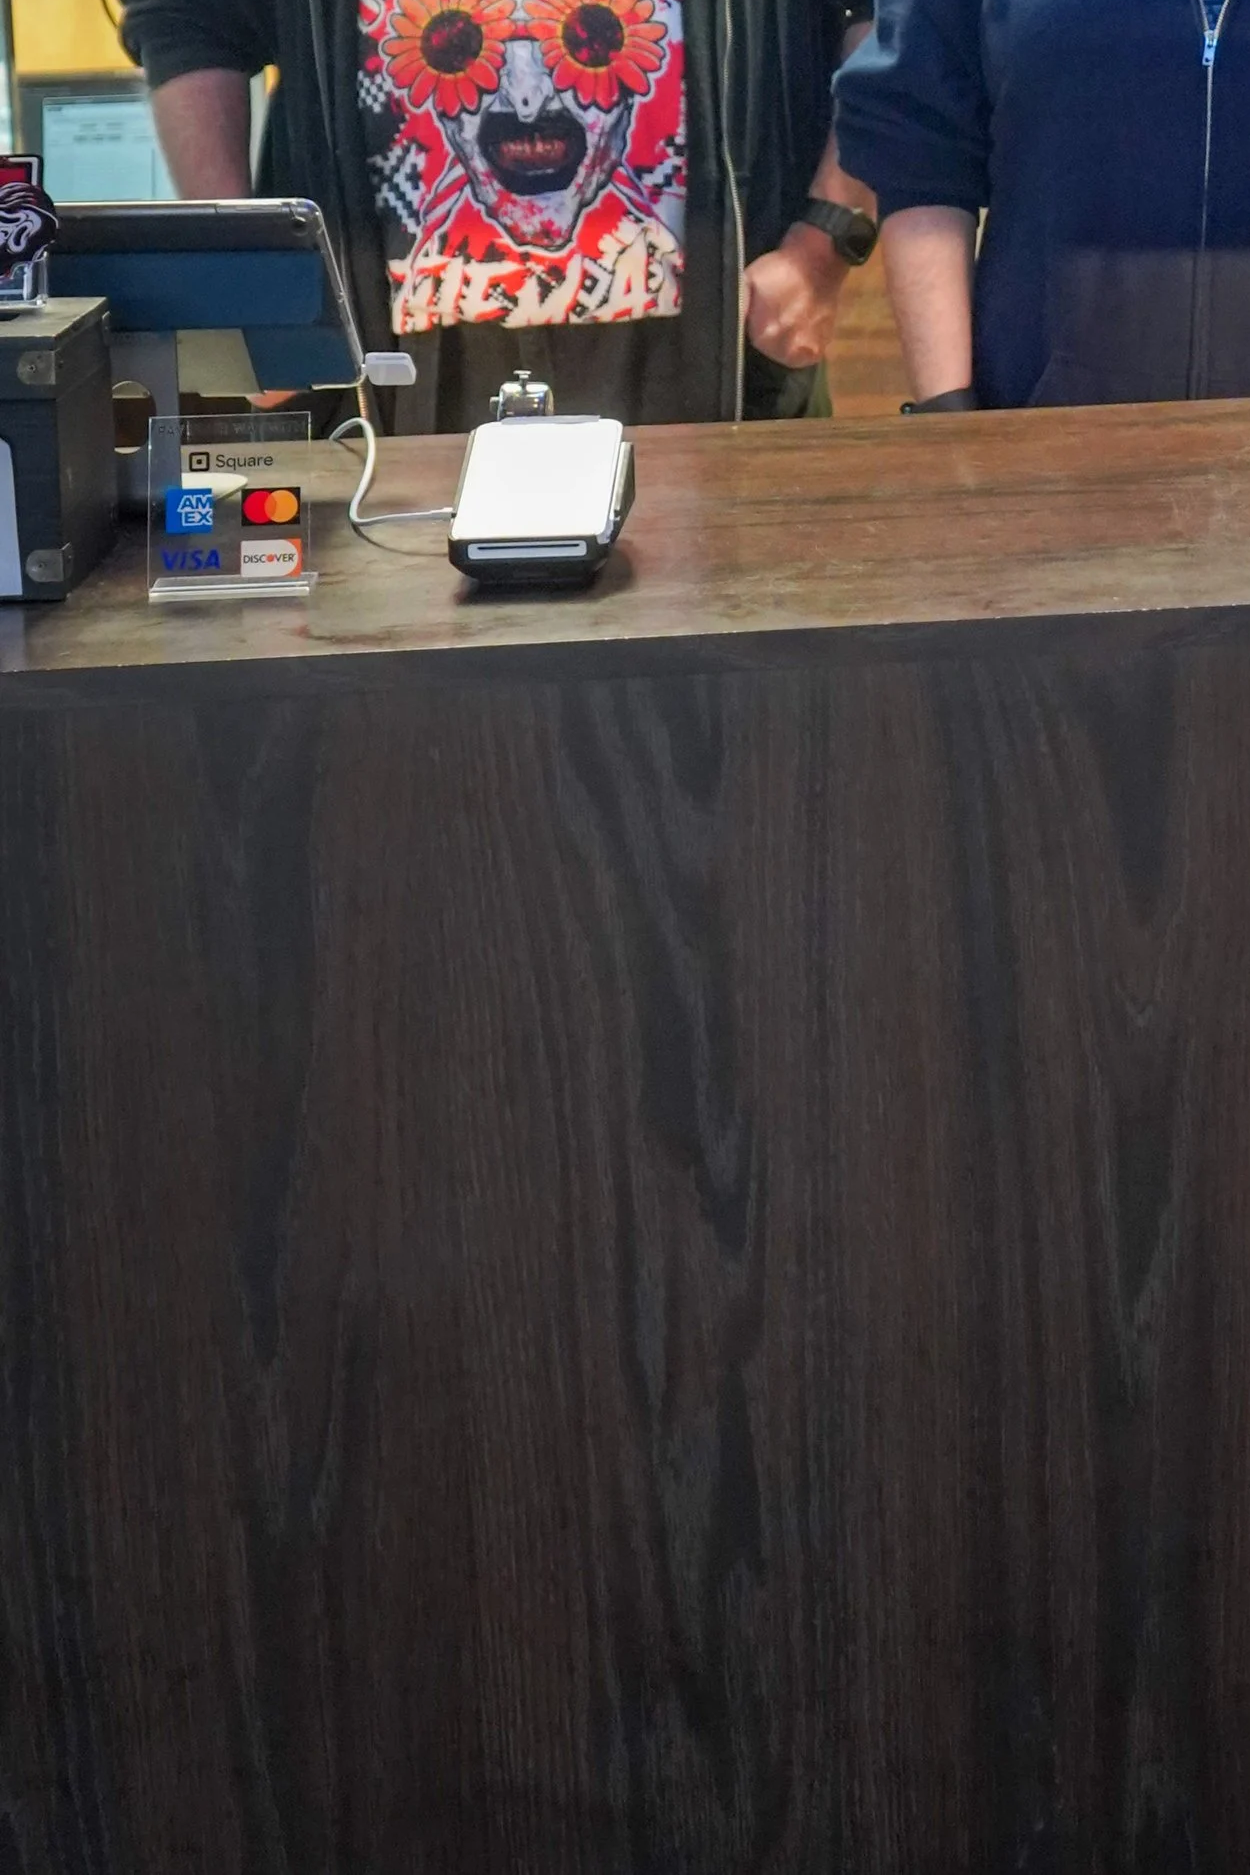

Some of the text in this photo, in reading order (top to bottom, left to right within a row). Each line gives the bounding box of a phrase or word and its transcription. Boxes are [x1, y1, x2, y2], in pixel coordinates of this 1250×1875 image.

[215, 454, 274, 471] Square
[161, 550, 222, 571] VISA
[243, 553, 296, 564] DISCOVER
